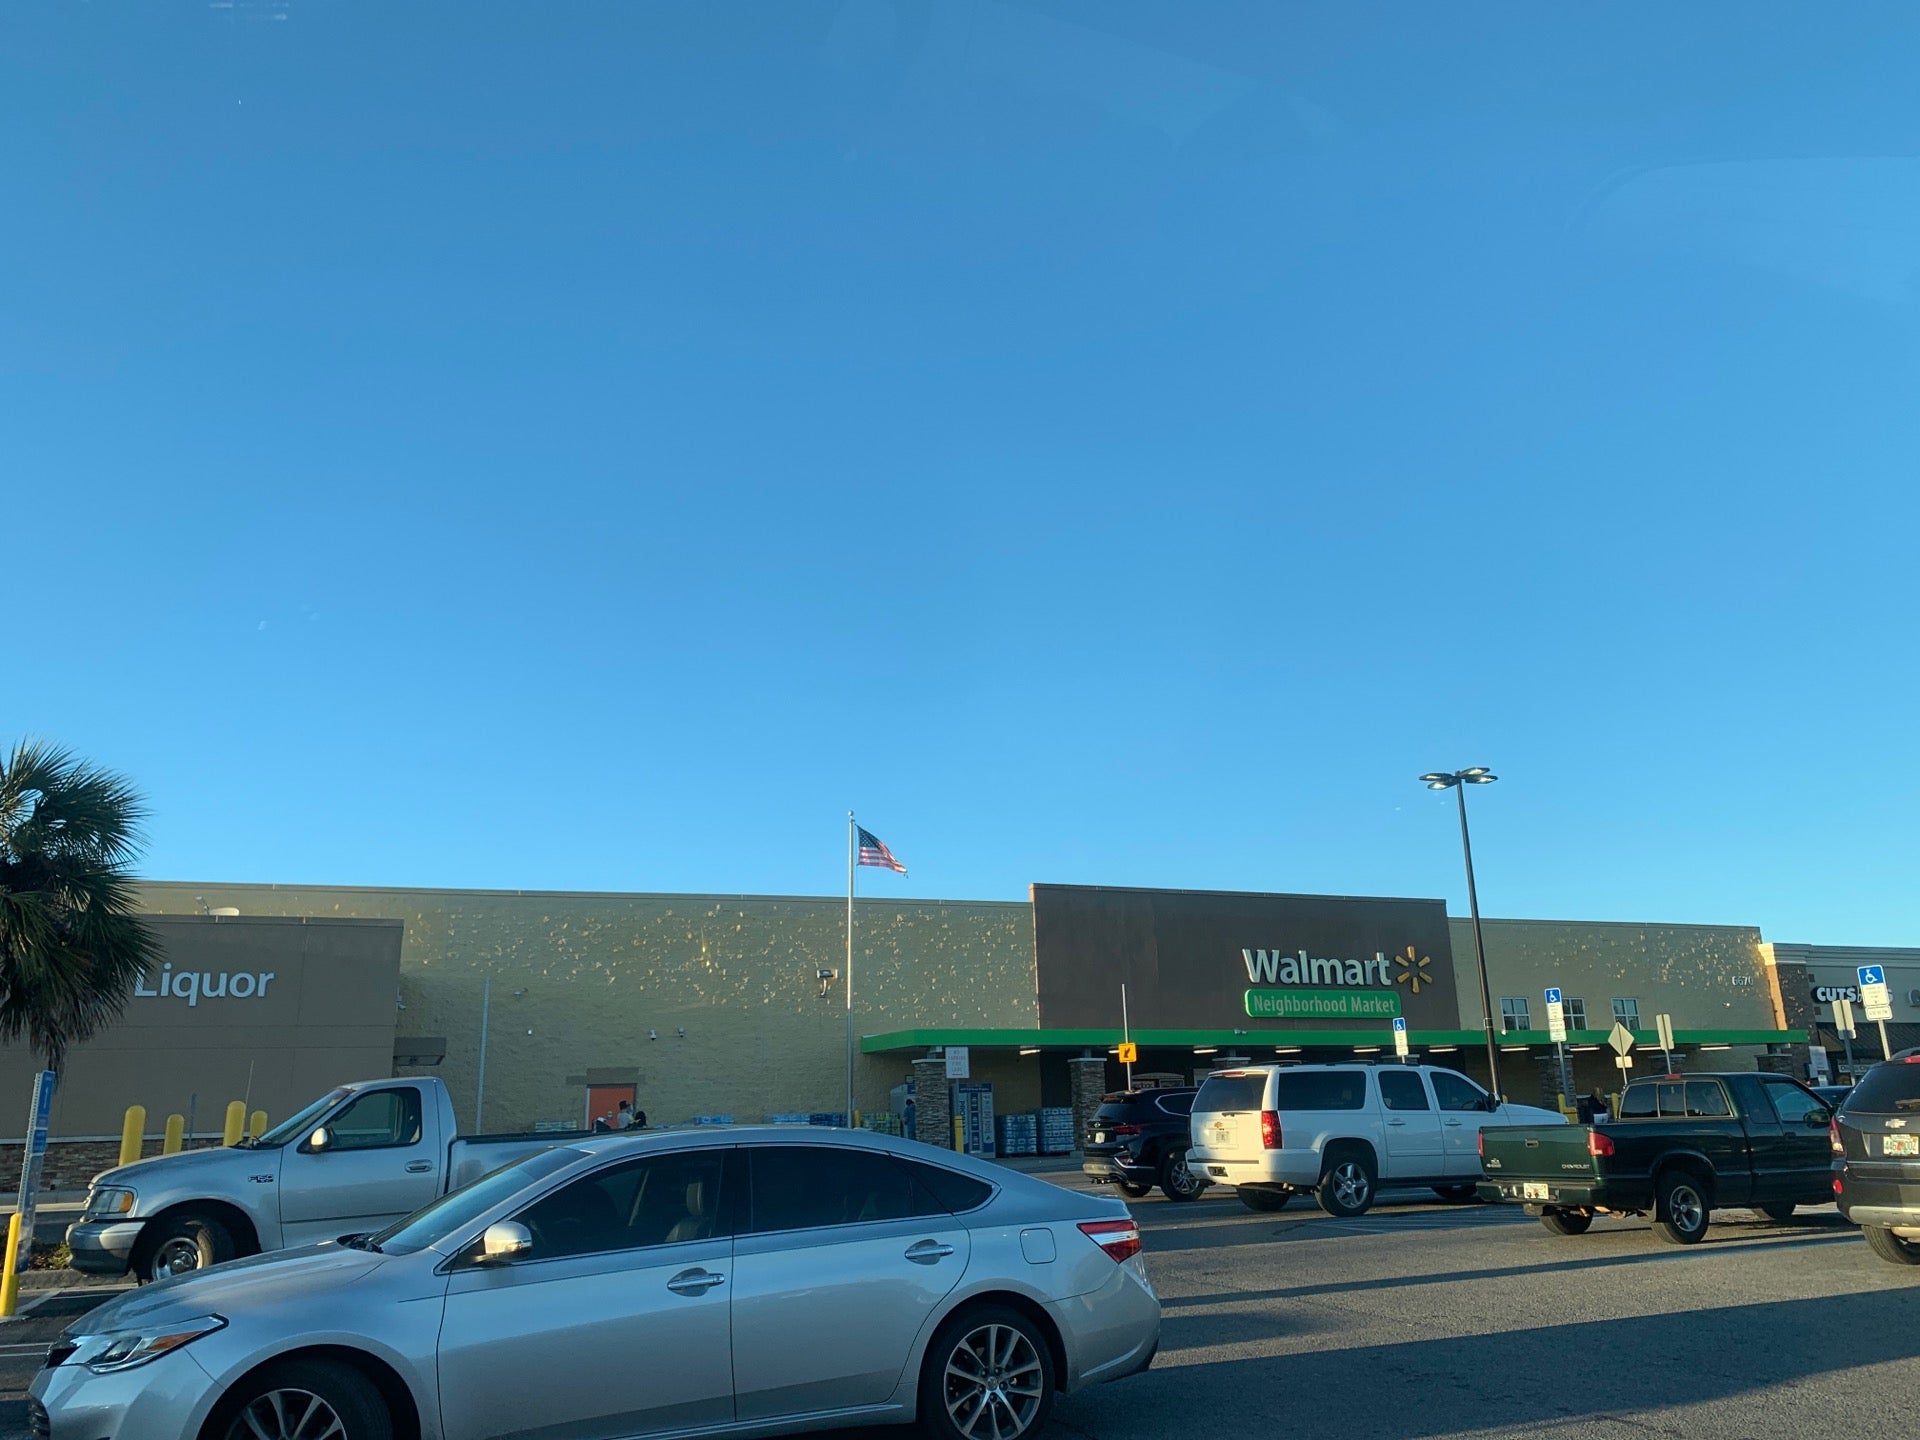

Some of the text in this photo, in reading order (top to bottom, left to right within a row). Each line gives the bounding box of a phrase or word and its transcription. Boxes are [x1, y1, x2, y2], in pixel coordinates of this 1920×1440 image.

[1242, 949, 1392, 986] Walmart
[134, 962, 275, 1007] Liquor
[1816, 986, 1857, 1003] CUTS
[1253, 995, 1395, 1016] Neighborhood Market
